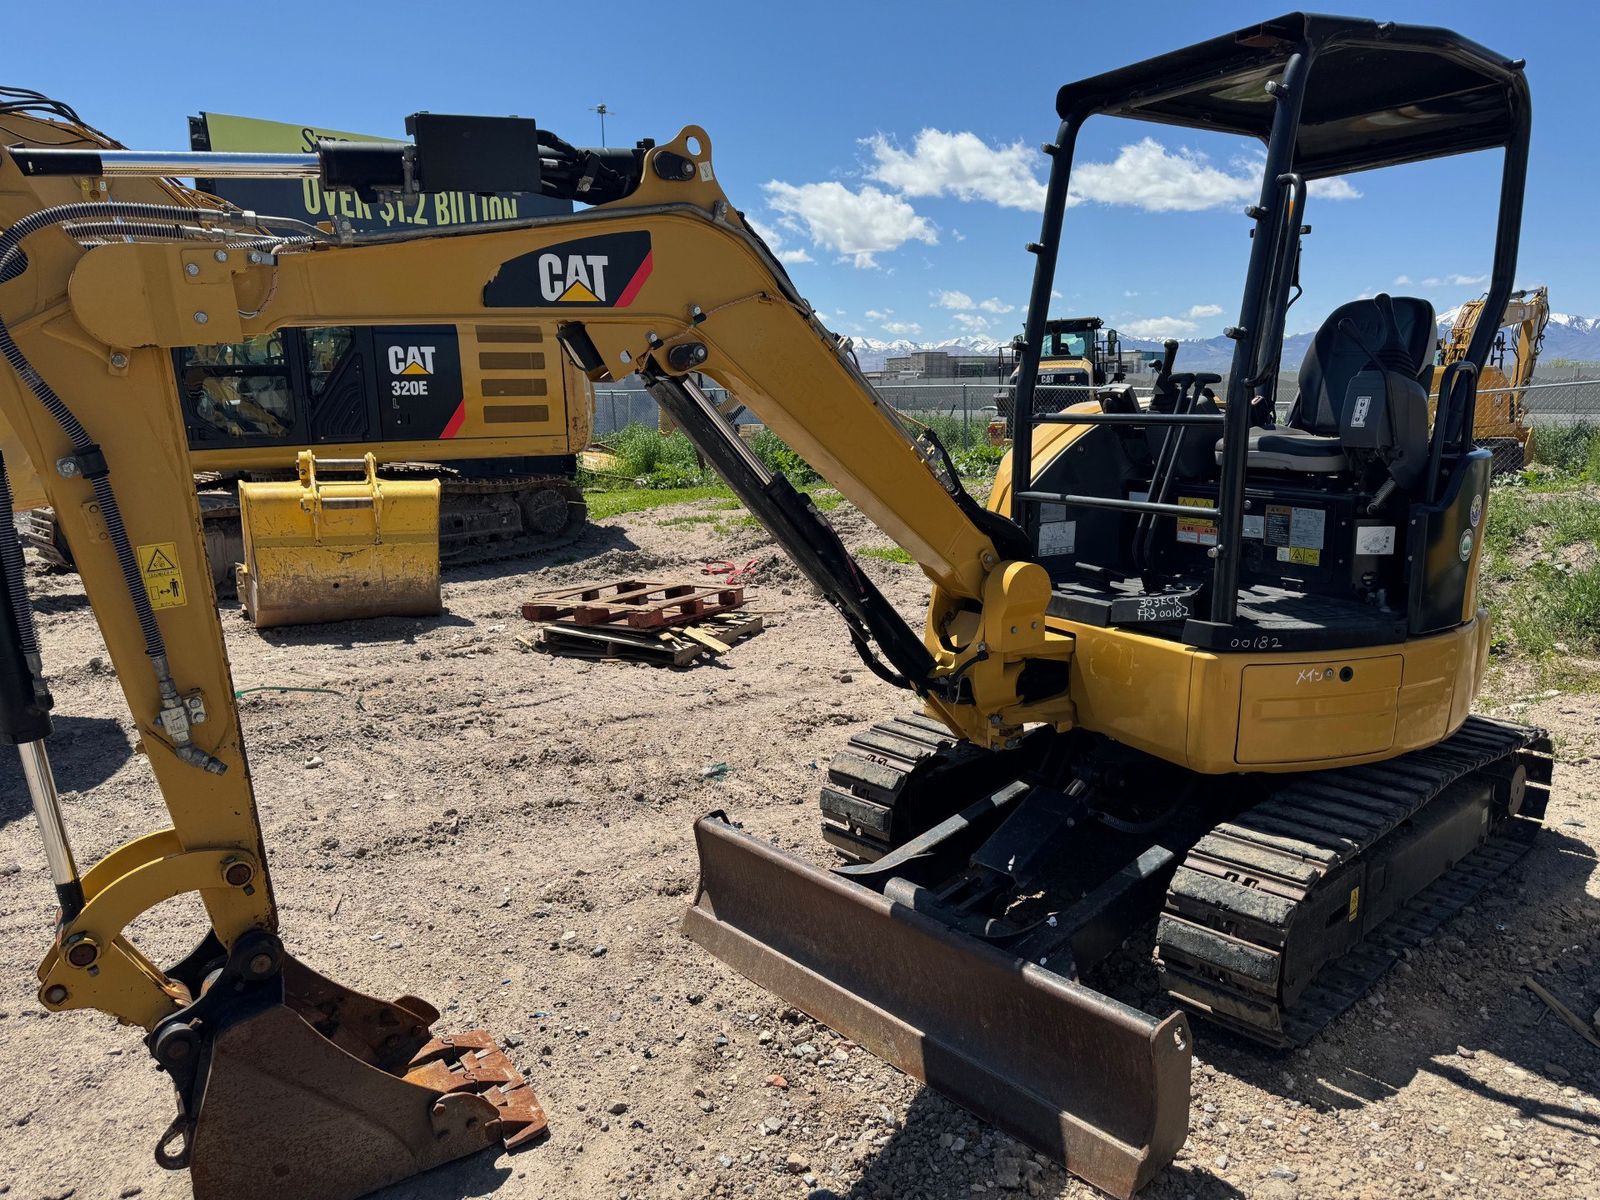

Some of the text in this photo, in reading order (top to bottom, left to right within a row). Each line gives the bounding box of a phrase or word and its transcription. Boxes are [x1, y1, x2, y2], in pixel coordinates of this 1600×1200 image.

[538, 253, 608, 301] CAT
[388, 346, 435, 374] CAT
[1041, 375, 1055, 384] CAT
[391, 381, 428, 395] 320E
[1159, 605, 1191, 618] 00182
[1230, 636, 1283, 649] 00182
